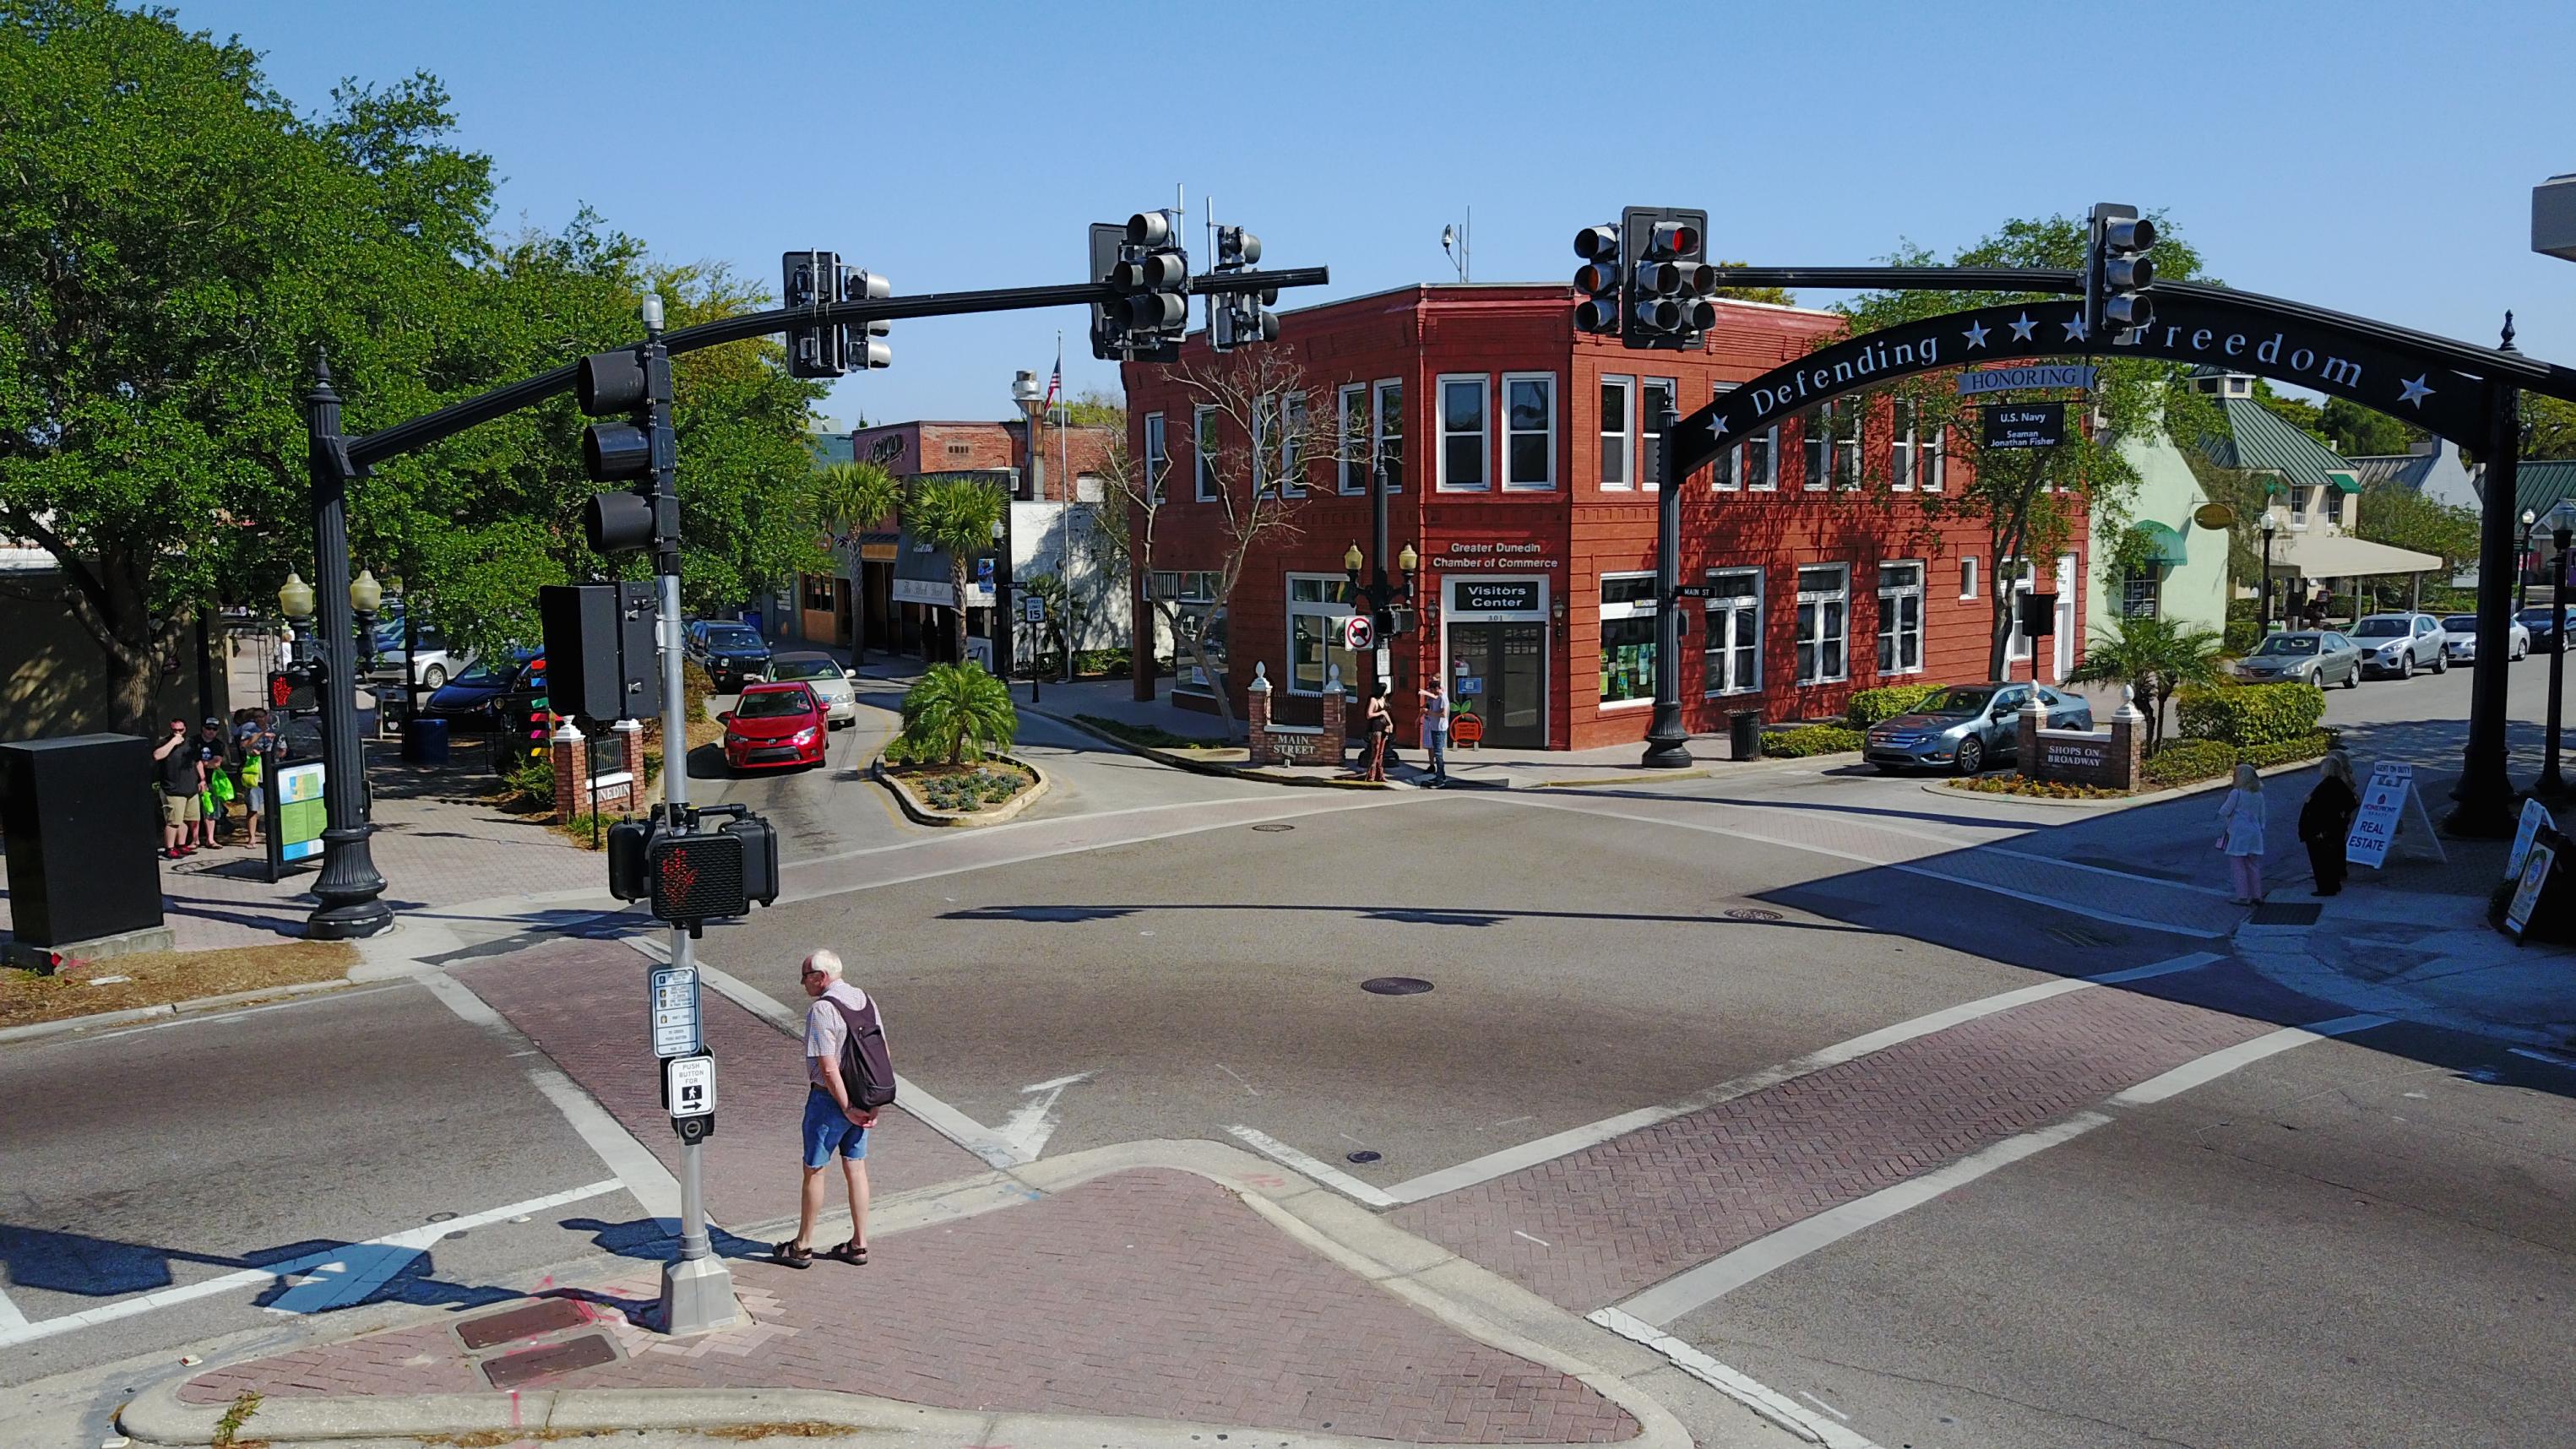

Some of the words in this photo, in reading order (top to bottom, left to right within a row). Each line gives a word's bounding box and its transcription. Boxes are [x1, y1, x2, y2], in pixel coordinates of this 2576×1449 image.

[1751, 336, 1937, 417] Defending
[1972, 367, 2076, 390] HONORING
[2000, 413, 2019, 422] U.S.
[2021, 413, 2046, 423] Navy
[1990, 438, 2027, 448] Jonathan
[2030, 437, 2055, 446] Fisher
[1451, 543, 1492, 553] Greater
[1496, 543, 1541, 553] Dunedin
[1433, 557, 1481, 567] Chamber
[1484, 557, 1495, 567] of
[1497, 558, 1558, 568] Commerce
[1468, 586, 1526, 595] Visitors
[1471, 598, 1524, 607] Center
[1030, 610, 1041, 619] 15
[1278, 735, 1309, 745] MAIN
[1273, 745, 1315, 755] STREET
[2049, 746, 2081, 756] SHOPS
[2047, 754, 2100, 767] BROADWAY
[587, 784, 630, 804] DNEDIN
[2360, 821, 2383, 834] REAL
[2349, 836, 2385, 851] ESTATE
